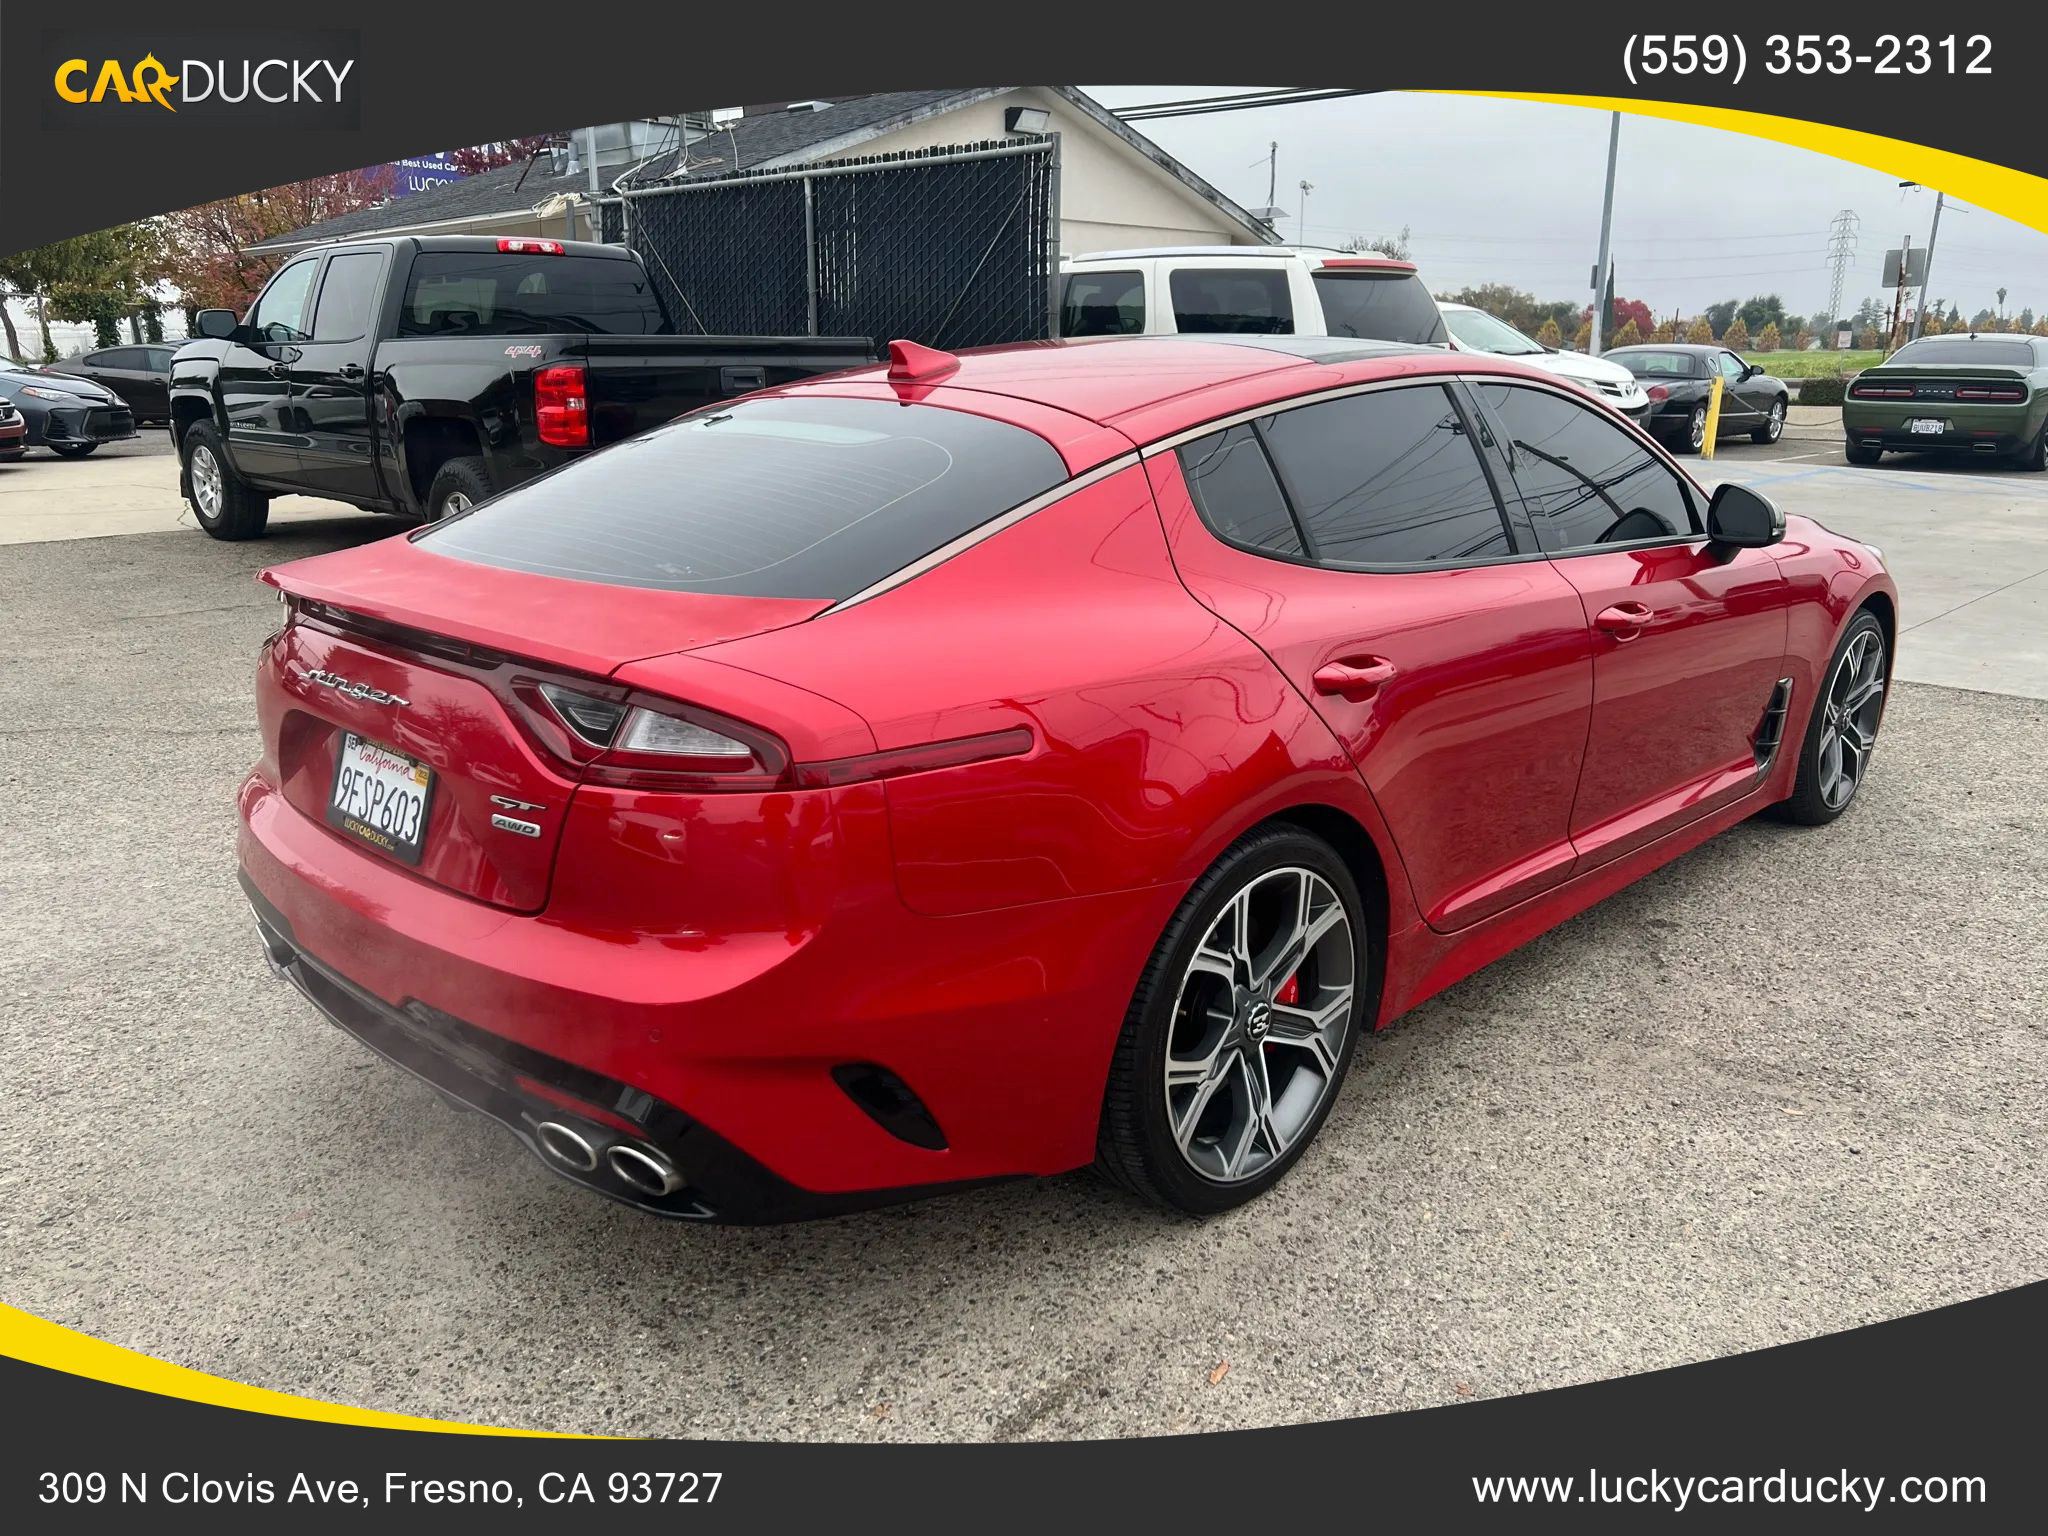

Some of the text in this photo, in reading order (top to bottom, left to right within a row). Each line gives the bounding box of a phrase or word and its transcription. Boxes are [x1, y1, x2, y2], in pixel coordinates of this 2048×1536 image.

[402, 160, 420, 168] Best
[422, 160, 443, 170] Used
[336, 766, 421, 842] 9FSP603
[494, 818, 537, 835] AWD
